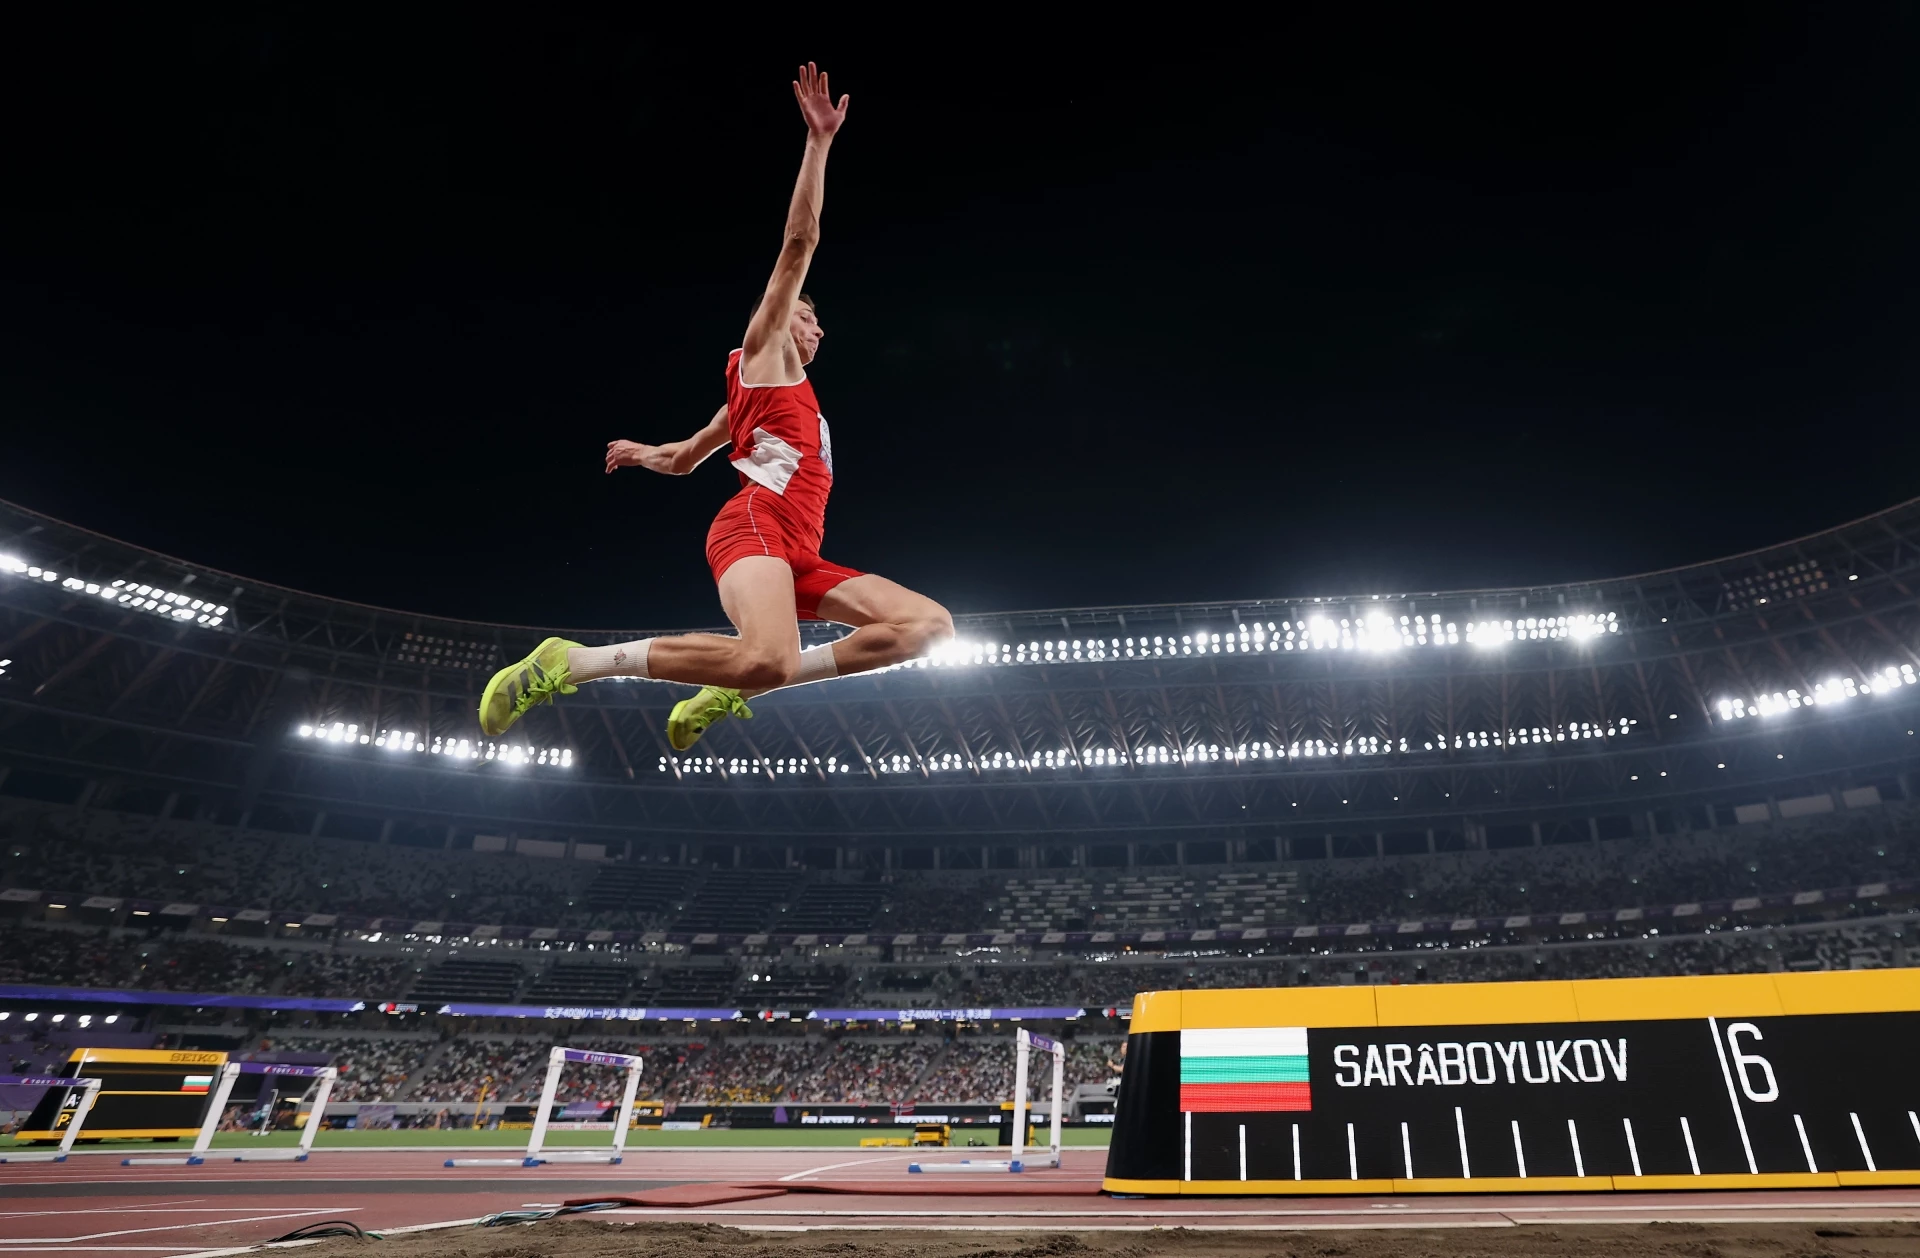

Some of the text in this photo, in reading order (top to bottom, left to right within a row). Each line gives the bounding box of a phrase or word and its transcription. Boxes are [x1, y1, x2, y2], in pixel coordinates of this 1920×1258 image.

[170, 1052, 219, 1062] SEIKO
[1333, 1038, 1628, 1087] SARÂBOYUKOV
[1726, 1022, 1780, 1103] 6
